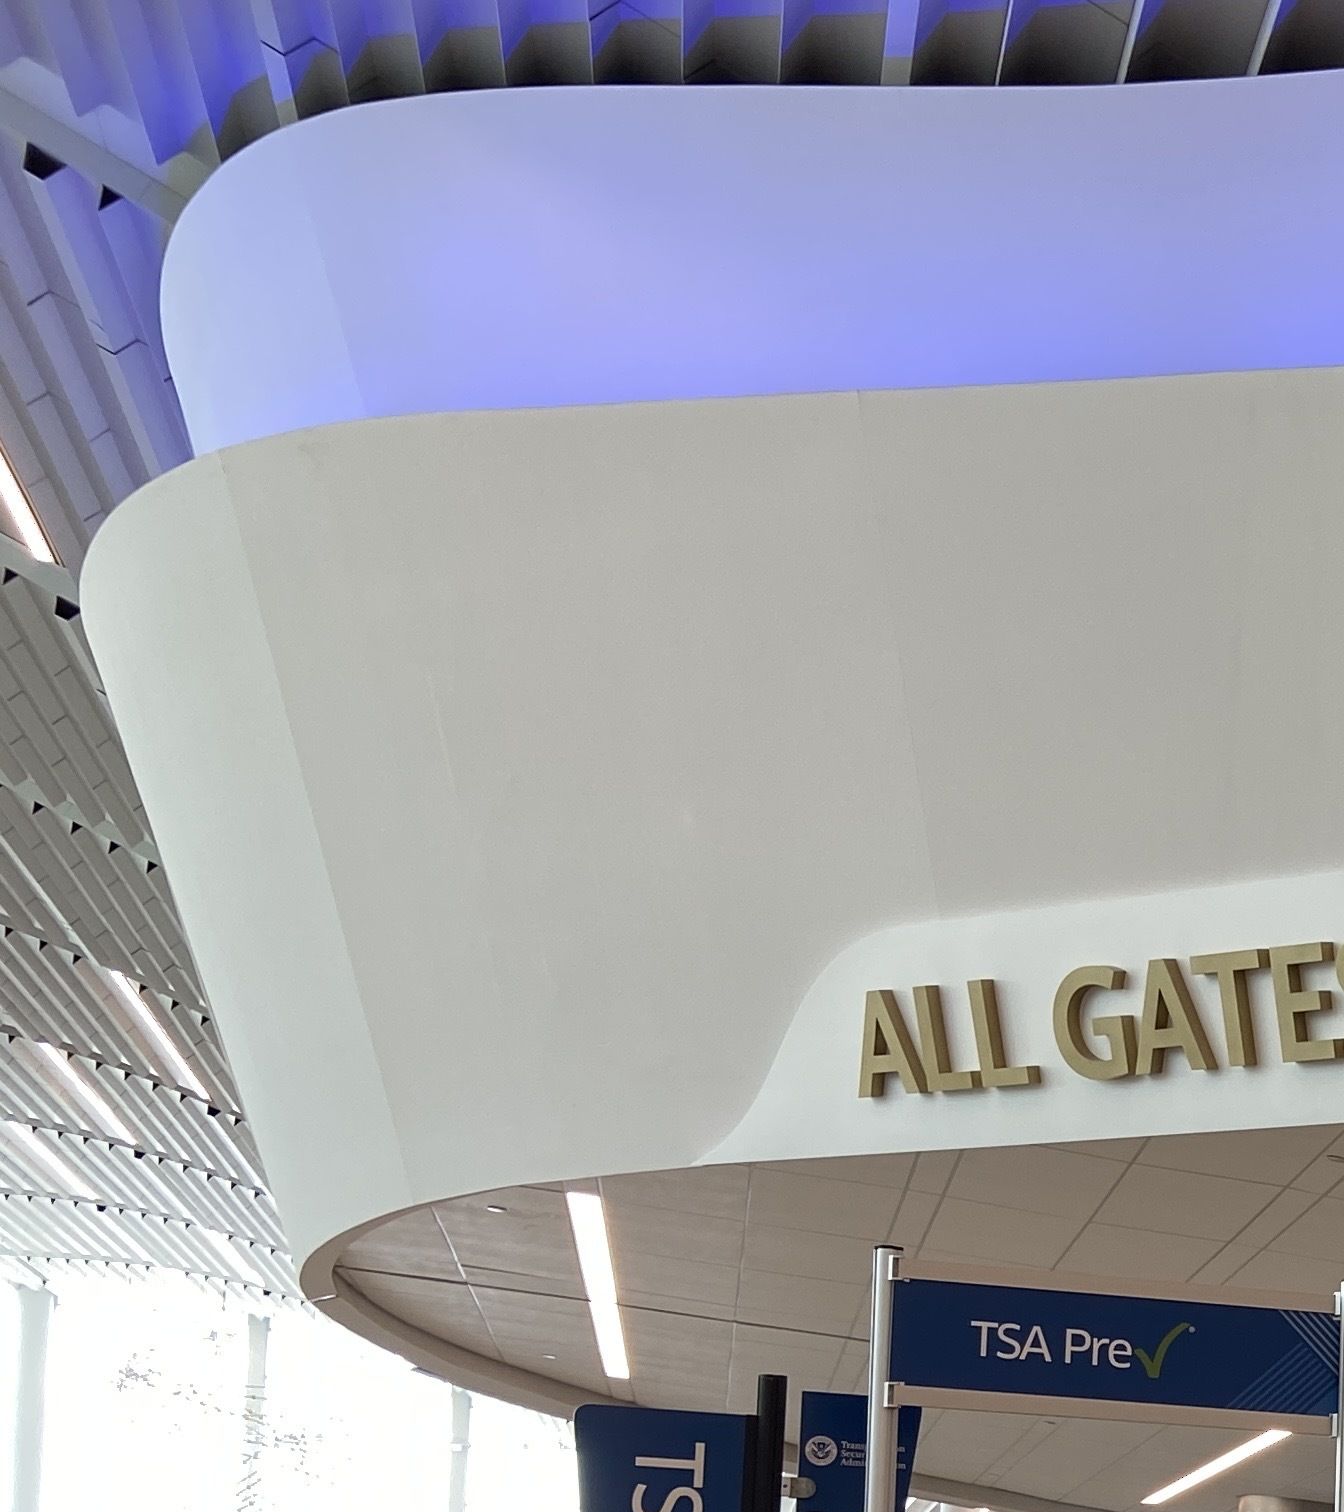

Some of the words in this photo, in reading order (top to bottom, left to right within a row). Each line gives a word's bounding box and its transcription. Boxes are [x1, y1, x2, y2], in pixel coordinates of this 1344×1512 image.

[858, 978, 1042, 1099] ALL
[970, 1319, 1053, 1362] TSA
[1063, 1327, 1133, 1369] Pre
[840, 1450, 866, 1458] Secur
